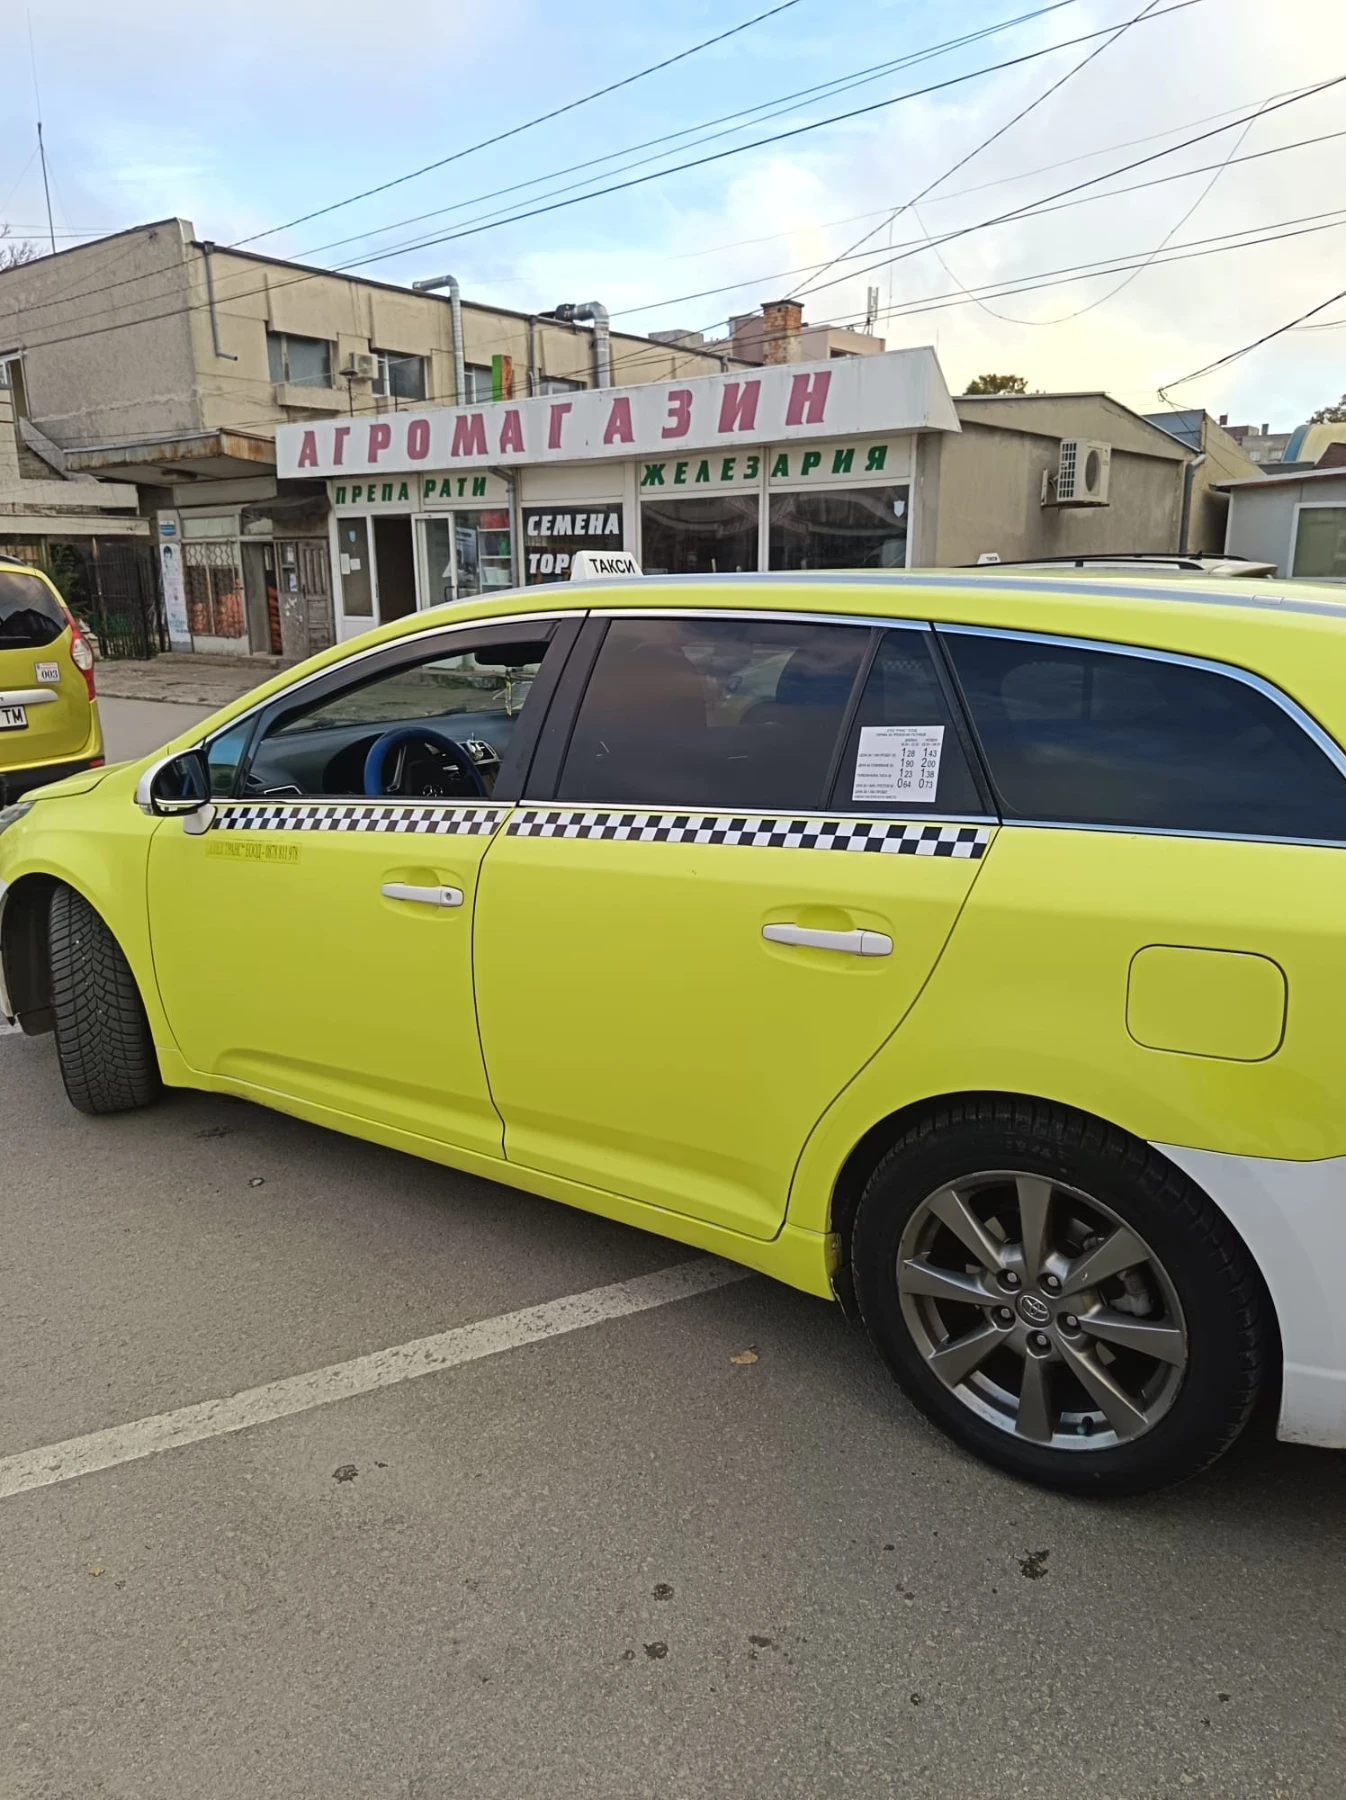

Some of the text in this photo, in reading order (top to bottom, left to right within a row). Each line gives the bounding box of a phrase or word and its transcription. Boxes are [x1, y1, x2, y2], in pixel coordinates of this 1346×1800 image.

[297, 370, 833, 468] АГРОМАГАЗИН
[640, 444, 888, 487] ЖЕЛЕЗАРИЯ
[527, 513, 620, 536] СЕМЕНА
[589, 558, 636, 574] ТАКСИ
[41, 670, 58, 679] 003
